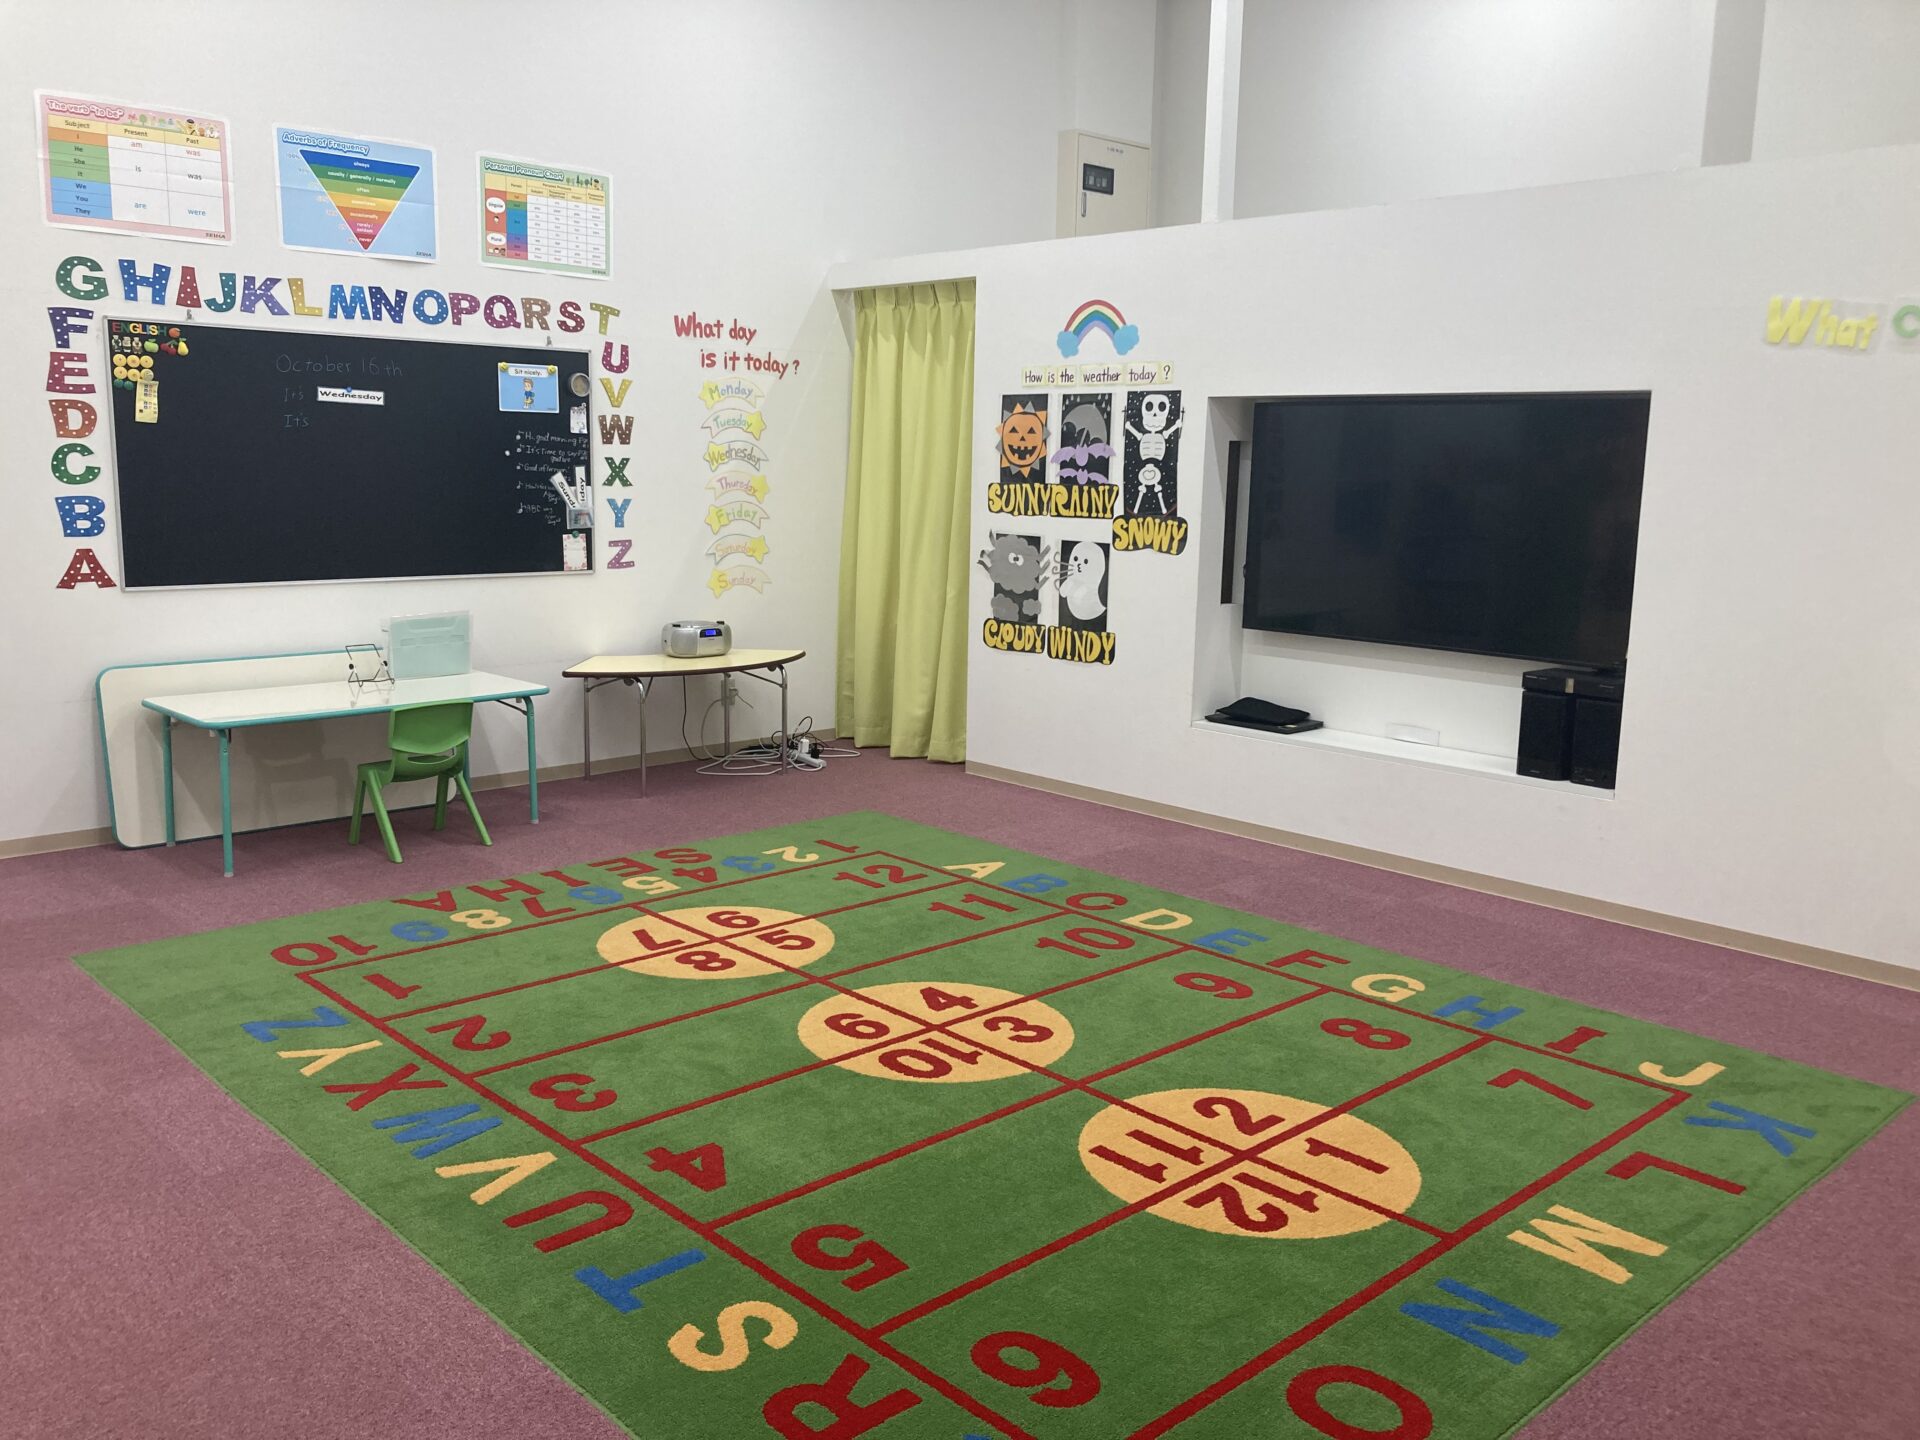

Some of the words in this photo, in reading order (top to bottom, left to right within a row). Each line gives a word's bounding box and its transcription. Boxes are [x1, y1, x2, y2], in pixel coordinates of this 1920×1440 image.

[48, 100, 65, 111] The
[69, 104, 89, 113] verb
[65, 120, 90, 129] Subject
[124, 129, 148, 138] Present
[74, 145, 83, 153] He
[130, 141, 143, 149] am
[185, 137, 199, 145] Past
[186, 149, 201, 157] was
[283, 133, 317, 146] Adverbs
[318, 137, 327, 147] of
[328, 140, 369, 155] Frequency
[353, 160, 370, 168] always
[485, 161, 515, 172] Personal
[516, 166, 545, 177] Pronoun
[544, 171, 564, 180] Chart
[74, 207, 91, 216] They
[134, 202, 147, 210] are
[187, 208, 206, 216] were
[55, 256, 109, 301] G
[118, 259, 171, 306] H
[175, 266, 201, 309] I
[203, 273, 237, 313] J
[240, 275, 290, 316] K
[287, 277, 323, 317] L
[328, 284, 371, 320] M
[369, 286, 407, 324] N
[413, 289, 449, 325] O
[448, 291, 482, 326] P
[483, 294, 522, 330] Q
[520, 297, 552, 331] R
[556, 301, 586, 334] S
[590, 302, 621, 336] T
[47, 306, 94, 349] F
[112, 322, 168, 336] ENGLISH
[674, 312, 723, 339] What
[729, 318, 757, 345] day
[1766, 295, 1878, 351] What
[45, 352, 96, 395] E
[276, 353, 351, 373] October
[601, 341, 630, 374] U
[701, 349, 717, 368] is
[724, 351, 740, 371] it
[744, 352, 788, 380] today
[708, 381, 754, 400] Monday
[1024, 370, 1043, 384] How
[1047, 371, 1055, 383] is
[1060, 368, 1075, 383] the
[1083, 367, 1121, 383] weather
[1128, 367, 1157, 383] today
[319, 390, 382, 402] Wednesday
[599, 378, 632, 408] V
[48, 400, 97, 438] D
[598, 415, 634, 446] W
[713, 413, 753, 430] Tuesday
[50, 443, 101, 485] C
[708, 445, 761, 466] Wednesday
[602, 456, 633, 488] X
[716, 476, 758, 495] Thursday
[558, 481, 576, 508] Sund
[988, 484, 1050, 516] SUNNY
[1050, 484, 1119, 518] RAINY
[54, 496, 106, 538] B
[606, 498, 632, 529] Y
[715, 503, 758, 524] Friday
[1113, 516, 1187, 555] SNOWY
[55, 548, 117, 590] A
[606, 539, 635, 570] Z
[716, 572, 756, 589] Sunday
[984, 618, 1046, 654] CLOUDY
[1050, 626, 1115, 665] WINDY
[756, 928, 816, 951] 5
[674, 950, 737, 972] 8
[941, 860, 1006, 880] A
[1004, 873, 1070, 894] B
[1065, 892, 1128, 911] C
[1120, 908, 1194, 930] D
[1193, 927, 1270, 954] E
[1266, 948, 1352, 970] F
[1351, 973, 1426, 1003] G
[1433, 995, 1525, 1029] H
[1544, 1026, 1607, 1054] I
[1638, 1061, 1726, 1086] J
[363, 973, 423, 999] 1
[919, 986, 980, 1013] 4
[240, 1005, 350, 1043] Z
[424, 1015, 512, 1051] 2
[983, 1015, 1055, 1044] 3
[1319, 1018, 1412, 1050] 8
[277, 1040, 383, 1077] Y
[321, 1063, 448, 1111] X
[529, 1073, 618, 1112] 3
[371, 1103, 503, 1159] W
[1193, 1096, 1286, 1137] 2
[1684, 1101, 1817, 1157] K
[642, 1142, 727, 1192] 4
[1304, 1137, 1390, 1174] 1
[435, 1151, 558, 1205] V
[1605, 1151, 1746, 1195] L
[502, 1190, 634, 1253] U
[791, 1224, 910, 1292] 5
[1506, 1204, 1669, 1284] M
[574, 1248, 708, 1313] T
[668, 1301, 798, 1372] S
[1401, 1277, 1562, 1365] N
[762, 1353, 923, 1440] R
[1286, 1365, 1434, 1440] O
